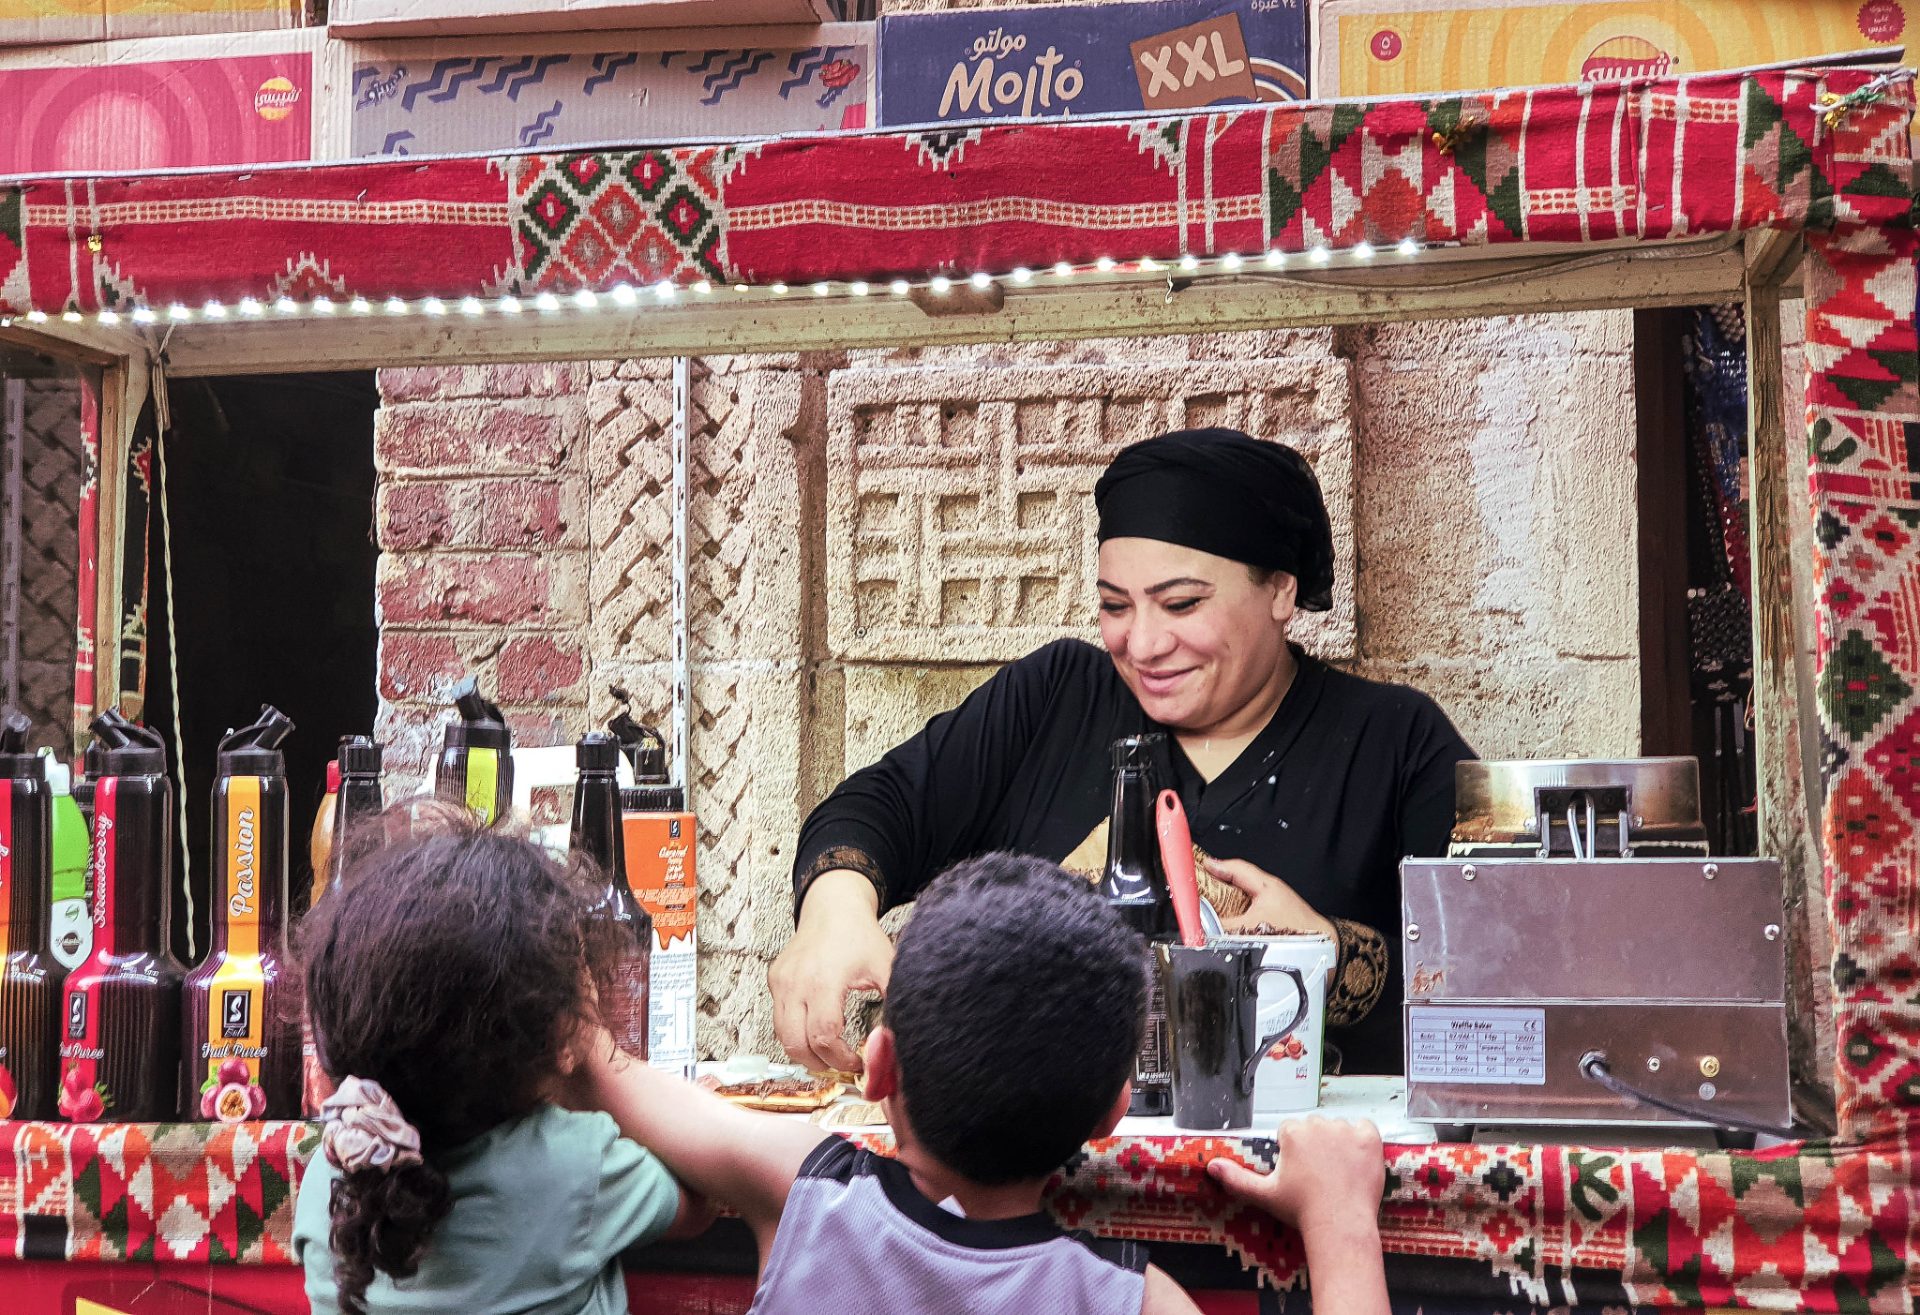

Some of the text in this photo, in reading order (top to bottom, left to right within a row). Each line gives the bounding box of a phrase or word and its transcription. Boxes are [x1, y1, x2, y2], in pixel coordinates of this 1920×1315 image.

[969, 27, 1027, 61] مولتو
[1139, 31, 1245, 98] XXL
[938, 46, 1084, 117] Molto
[94, 811, 113, 929] Strawberry
[229, 805, 255, 917] Passion
[201, 1042, 268, 1059] Fruit Puree
